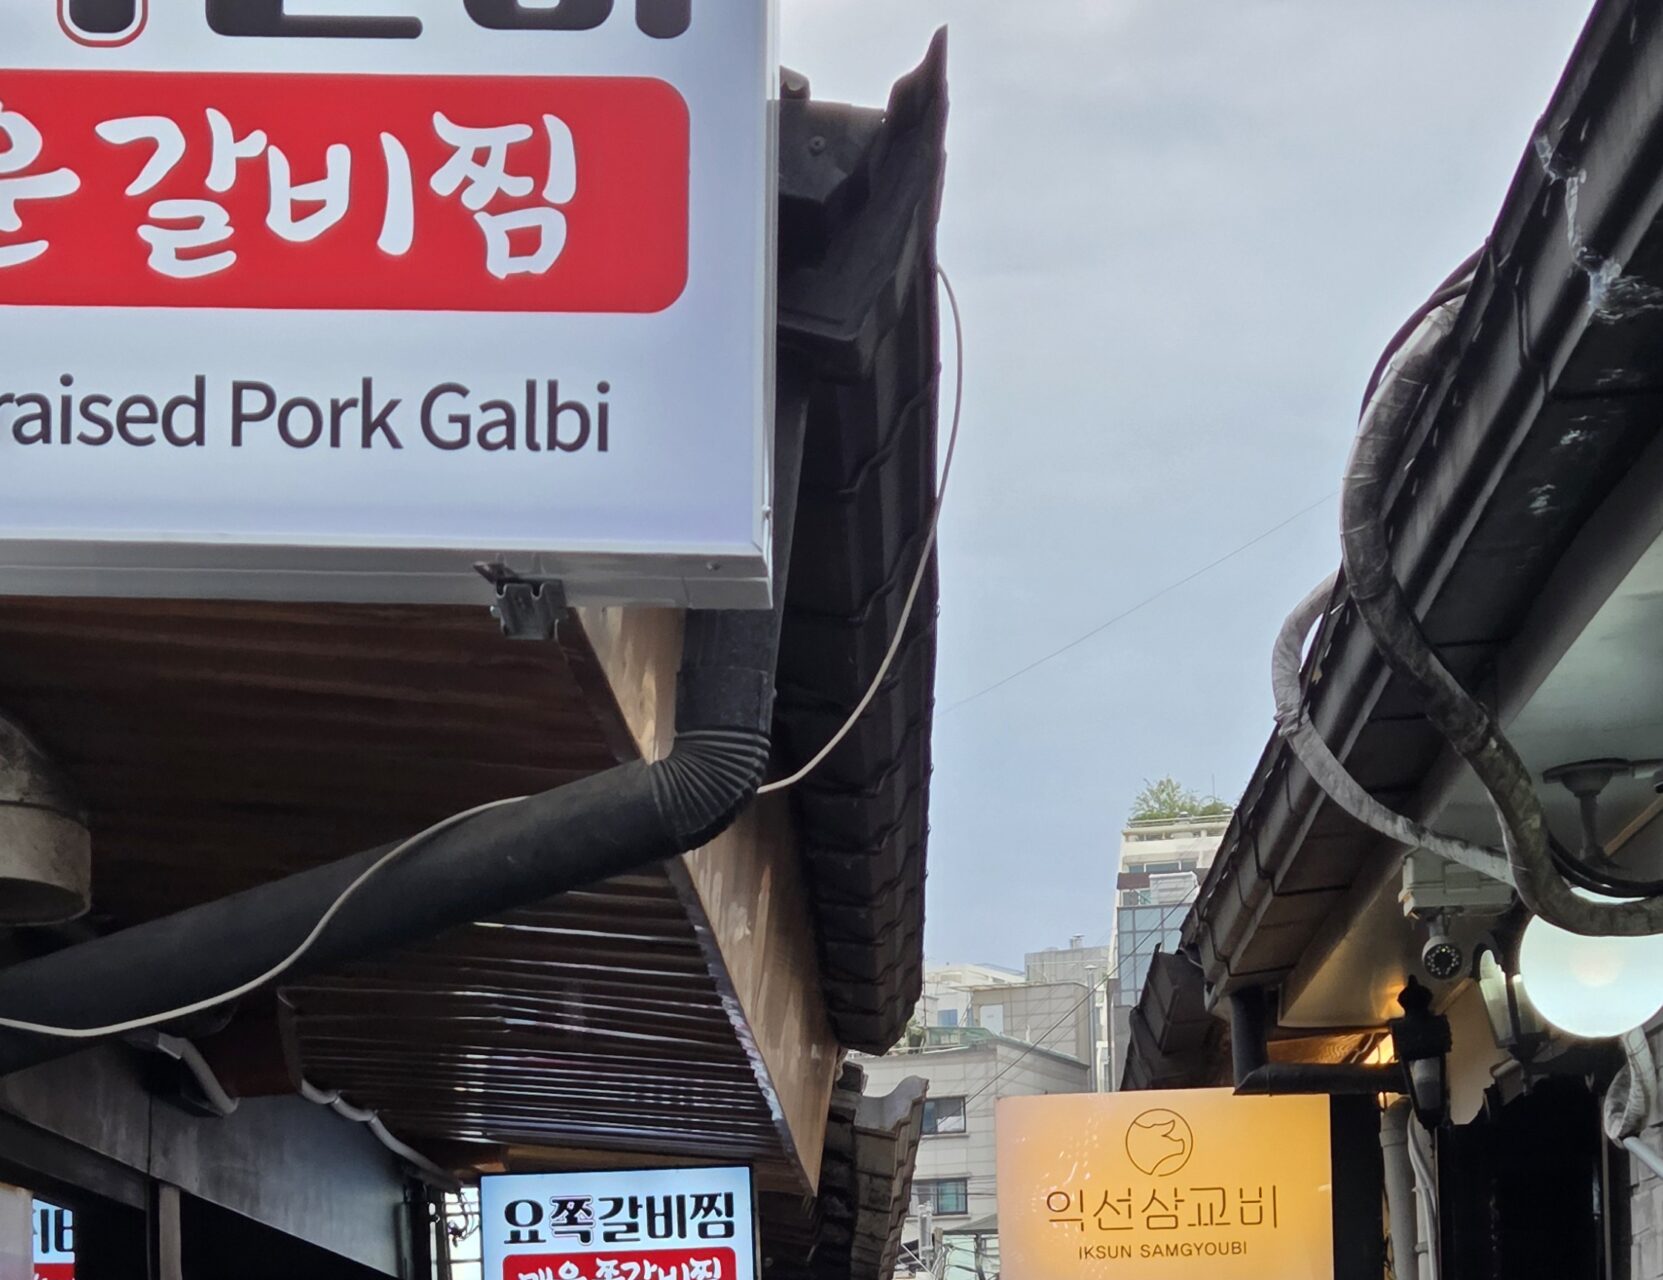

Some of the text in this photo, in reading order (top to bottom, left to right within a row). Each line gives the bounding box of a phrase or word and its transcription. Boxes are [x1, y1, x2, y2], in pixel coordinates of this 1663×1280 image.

[231, 376, 403, 450] Pork
[420, 379, 611, 452] Galbi
[1046, 1185, 1277, 1232] 익선삼교비
[1079, 1241, 1248, 1260] IKSUN SAMGYOUBI
